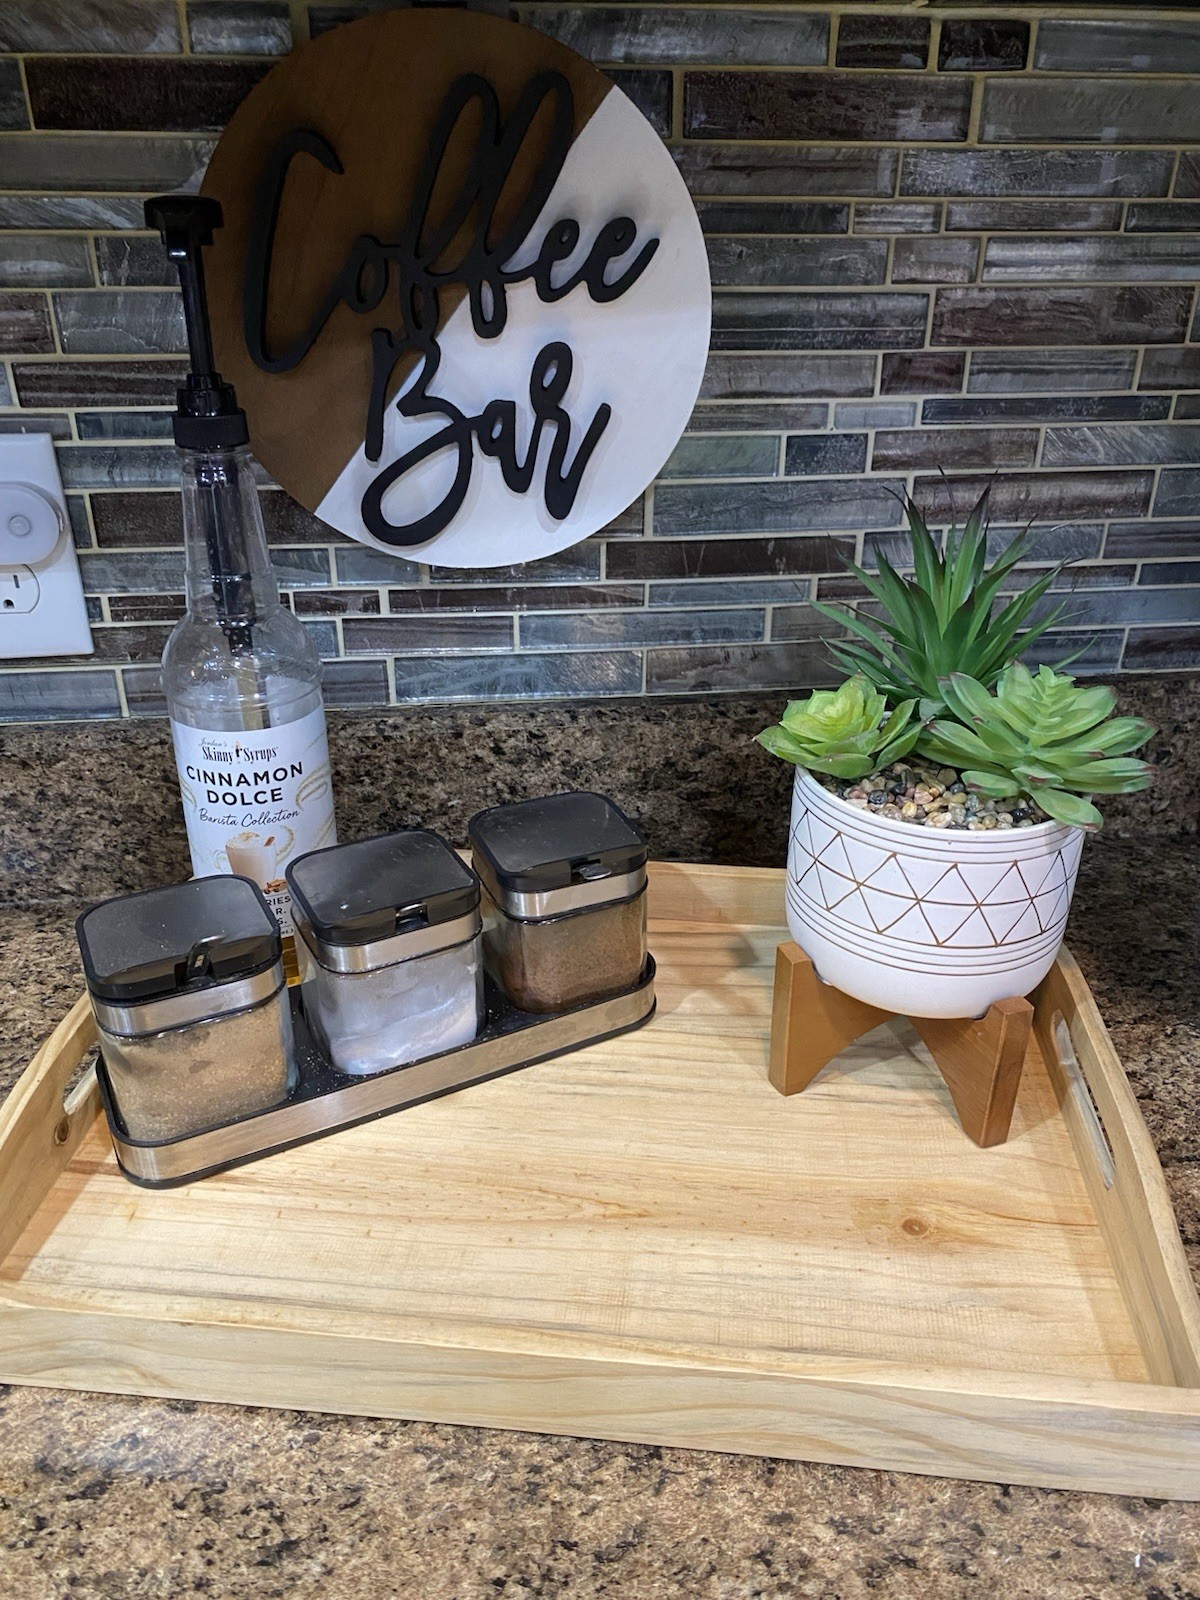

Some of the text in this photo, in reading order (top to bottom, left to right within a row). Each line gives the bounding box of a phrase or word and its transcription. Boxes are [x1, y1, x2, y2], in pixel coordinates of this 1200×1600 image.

[245, 72, 660, 374] Coffee
[361, 328, 611, 546] Bar
[202, 746, 277, 765] Skinny Syrups
[186, 761, 303, 787] CINNAMON
[206, 787, 283, 806] DOLCE
[199, 807, 300, 827] Barista Collection
[265, 896, 291, 906] RIES
